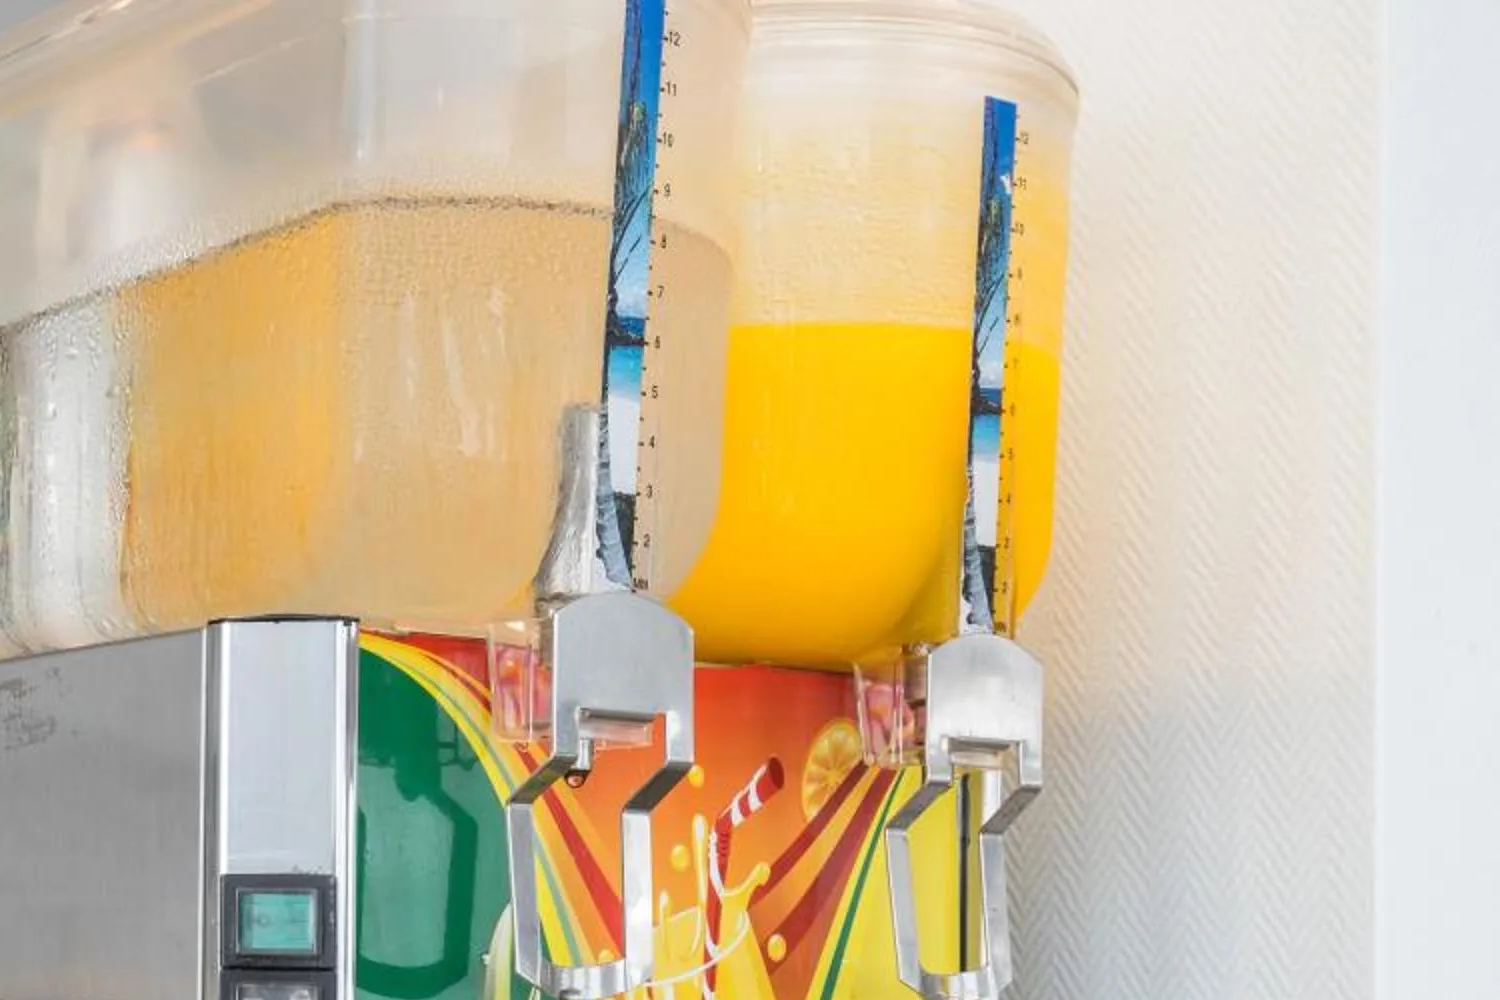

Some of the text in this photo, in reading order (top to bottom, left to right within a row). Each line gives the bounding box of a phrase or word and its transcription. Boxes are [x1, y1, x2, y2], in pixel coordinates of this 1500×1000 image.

[668, 31, 681, 46] 12
[665, 81, 677, 97] 11
[663, 132, 675, 147] 10
[663, 183, 671, 197] 9
[651, 386, 659, 399] 5
[648, 435, 656, 450] 4
[645, 485, 653, 499] 3
[643, 535, 651, 548] 2
